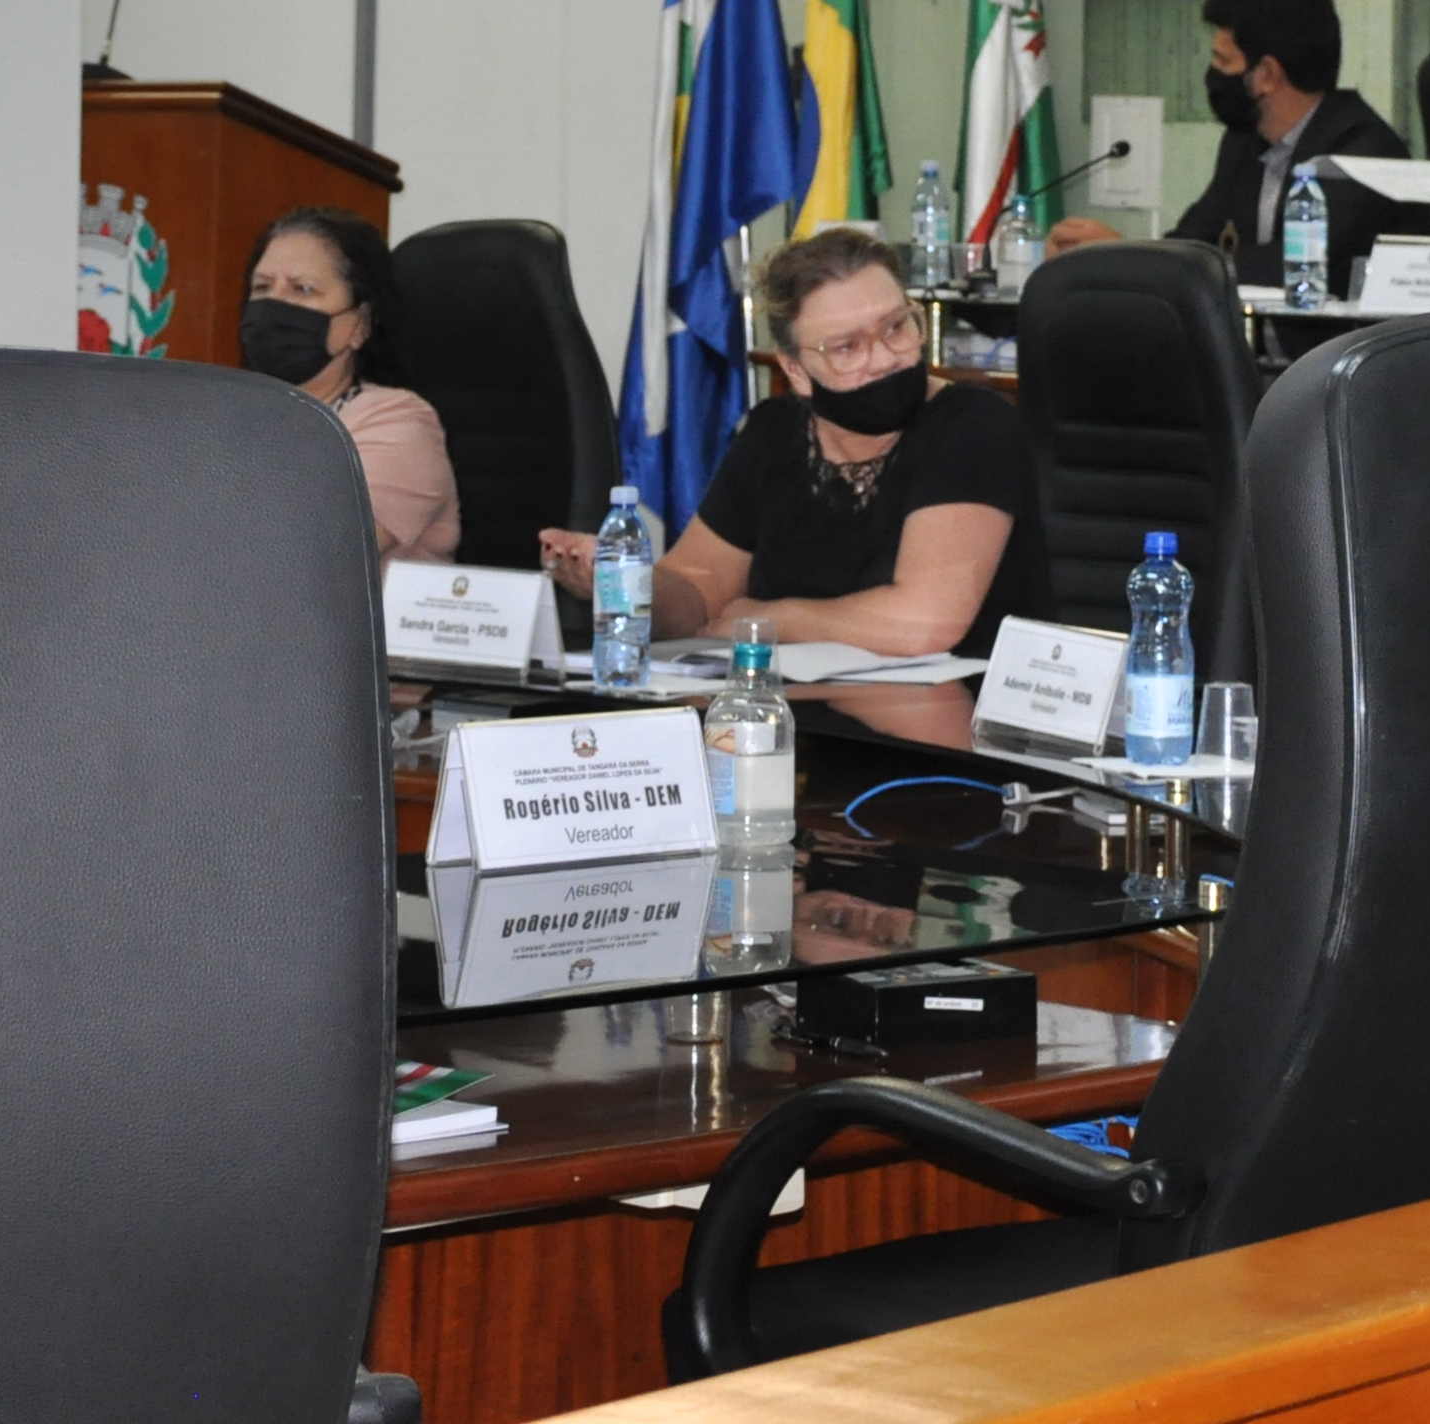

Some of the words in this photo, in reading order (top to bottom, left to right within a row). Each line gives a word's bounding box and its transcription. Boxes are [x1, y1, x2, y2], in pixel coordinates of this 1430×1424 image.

[400, 616, 433, 631] Sandra
[478, 624, 508, 638] PSDB
[542, 766, 576, 774] MUNICIPAL
[503, 792, 580, 820] Rogério
[583, 789, 631, 812] Silva
[644, 784, 682, 807] DEM
[564, 823, 634, 843] Vereador
